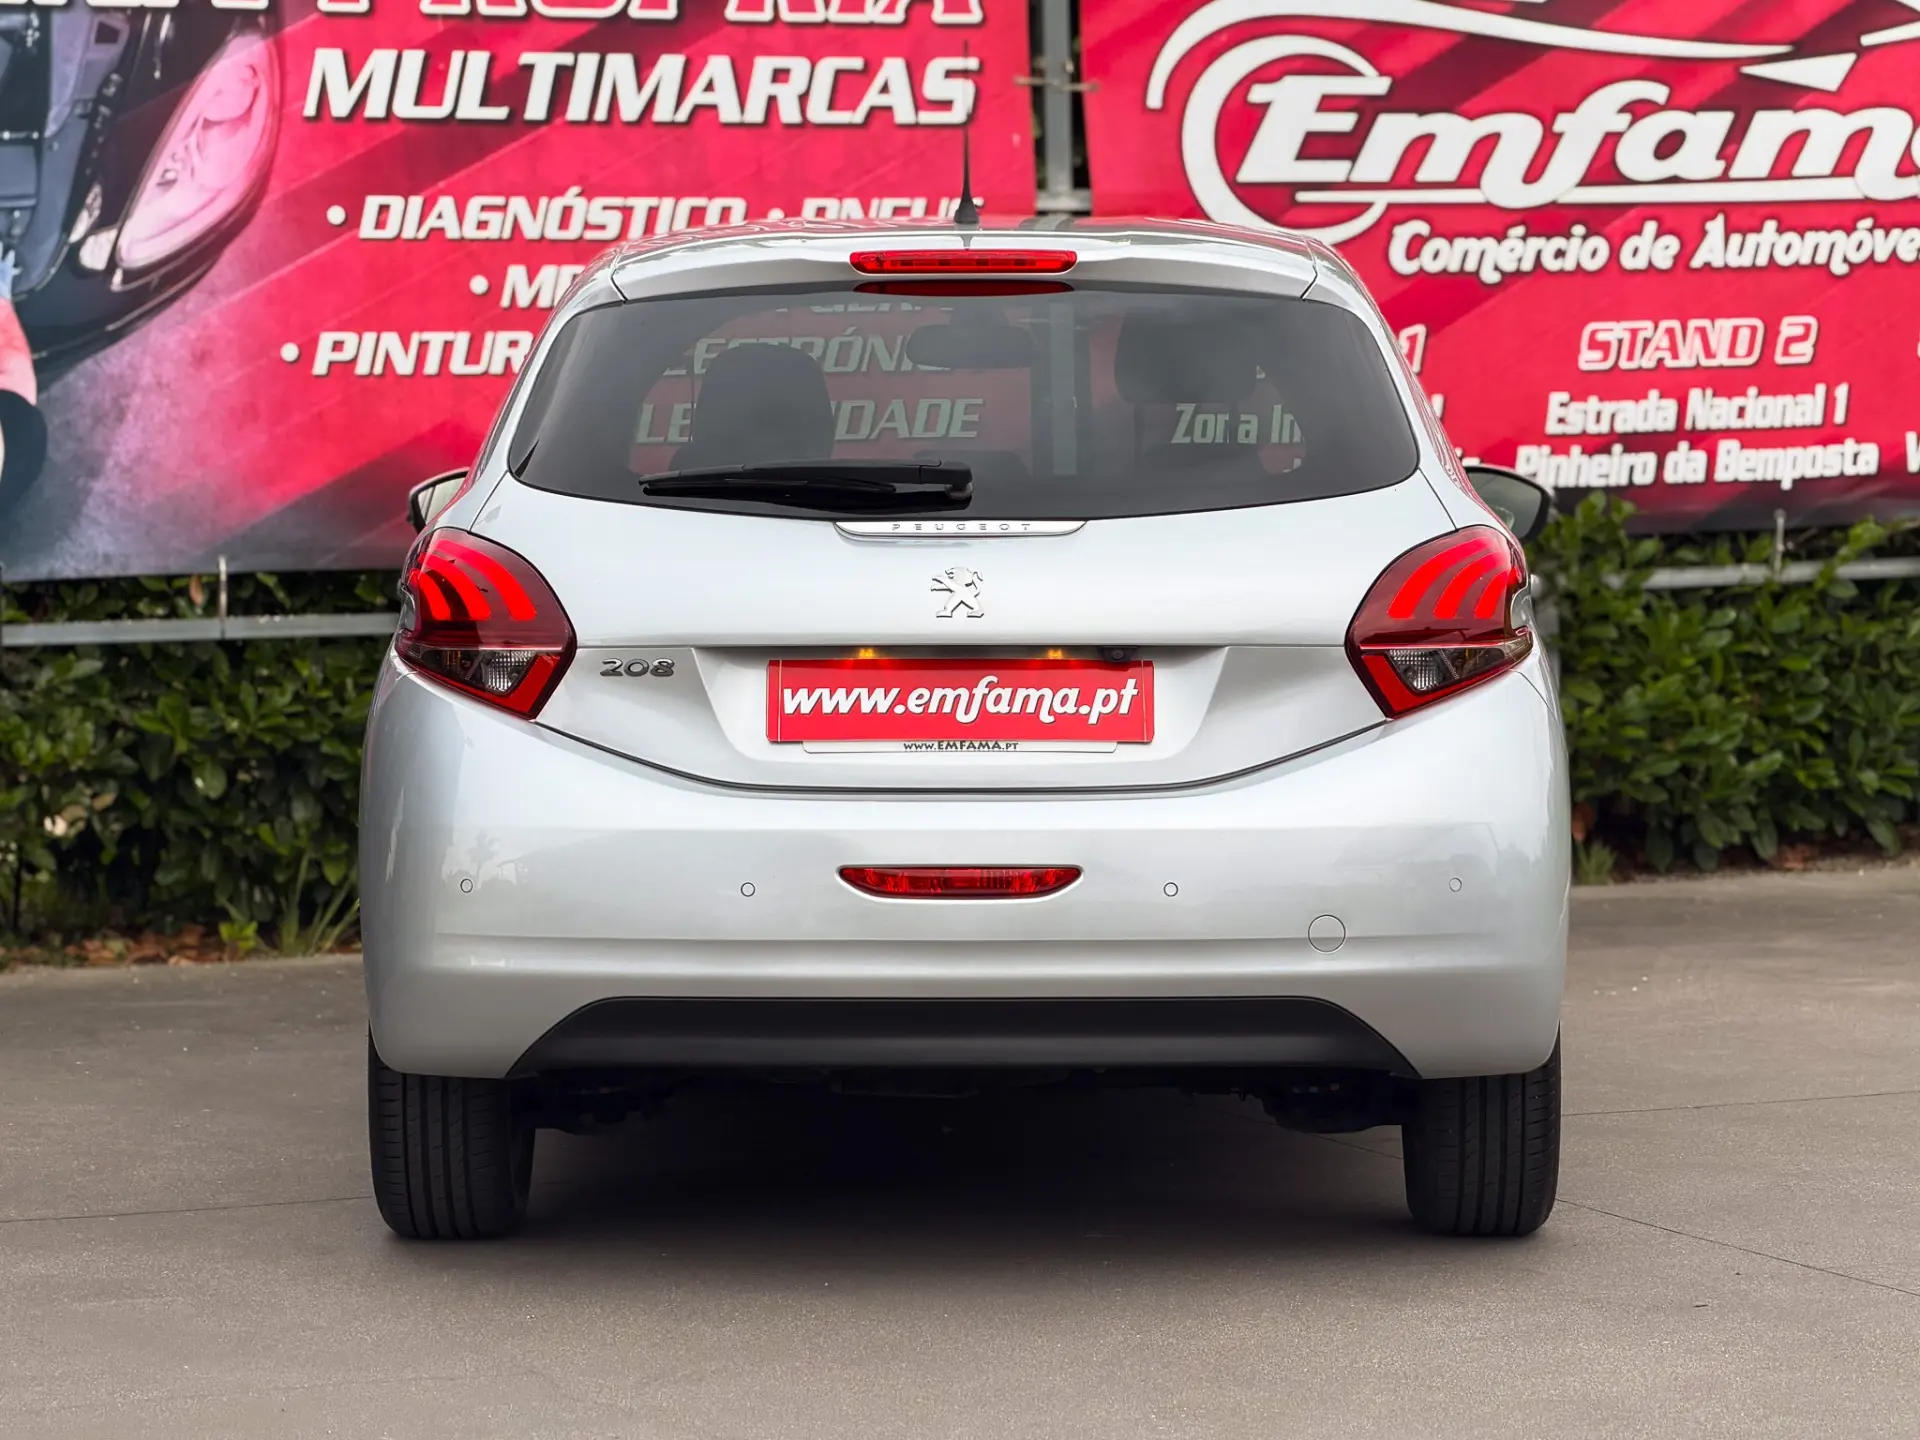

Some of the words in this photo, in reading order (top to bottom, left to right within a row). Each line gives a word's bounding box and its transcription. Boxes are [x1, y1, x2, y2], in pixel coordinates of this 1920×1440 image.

[303, 48, 979, 124] MULTIMARCAS
[1236, 76, 1920, 208] Emfam
[359, 187, 748, 241] DIAGNÓSTICO
[1388, 219, 1609, 284] Comércio
[1619, 219, 1680, 271] de
[1578, 317, 1765, 371] STAND
[1774, 315, 1819, 366] 2
[1544, 388, 1679, 435] Estrada
[1684, 382, 1827, 431] Nacional
[1833, 382, 1850, 425] 1
[1514, 441, 1658, 489] Pinheiro
[1663, 440, 1708, 484] da
[1714, 437, 1880, 490] Bemposta
[891, 522, 1031, 531] PEUGEOT
[600, 658, 675, 677] 208
[782, 675, 1140, 724] www.emfama.pt
